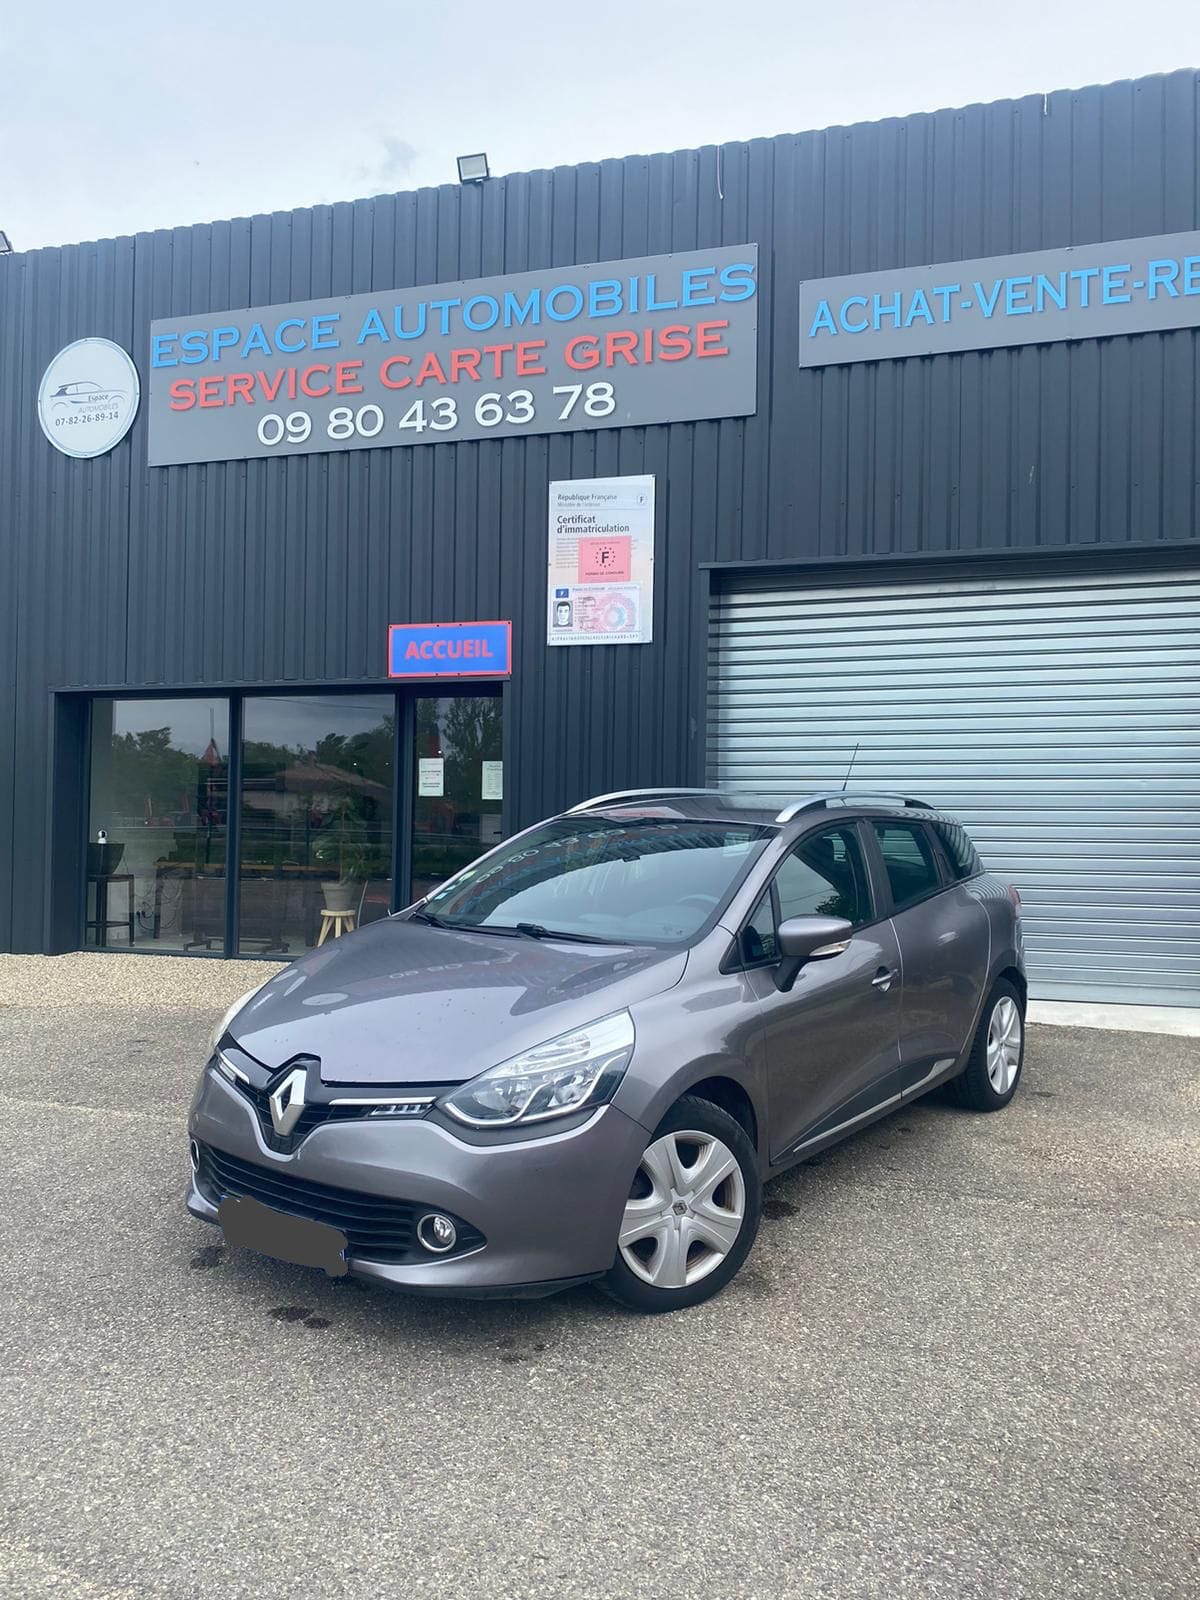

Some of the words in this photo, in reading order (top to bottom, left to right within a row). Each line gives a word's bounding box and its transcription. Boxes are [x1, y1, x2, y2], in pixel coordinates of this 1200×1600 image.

[151, 312, 341, 368] ESPACE
[356, 263, 757, 345] AUTOMOBILES
[168, 360, 364, 412] SERVICE
[379, 339, 547, 390] CARTE
[564, 320, 729, 371] GRISE
[55, 411, 119, 427] 07-82-26-89-14
[257, 411, 312, 446] 09
[327, 404, 384, 440] 80
[399, 396, 458, 433] 43
[474, 389, 536, 427] 63
[552, 382, 616, 421] 78
[557, 515, 596, 524] Certificat
[557, 524, 630, 534] d'immatriculation
[601, 551, 610, 564] F
[405, 639, 494, 660] ACCUEIL
